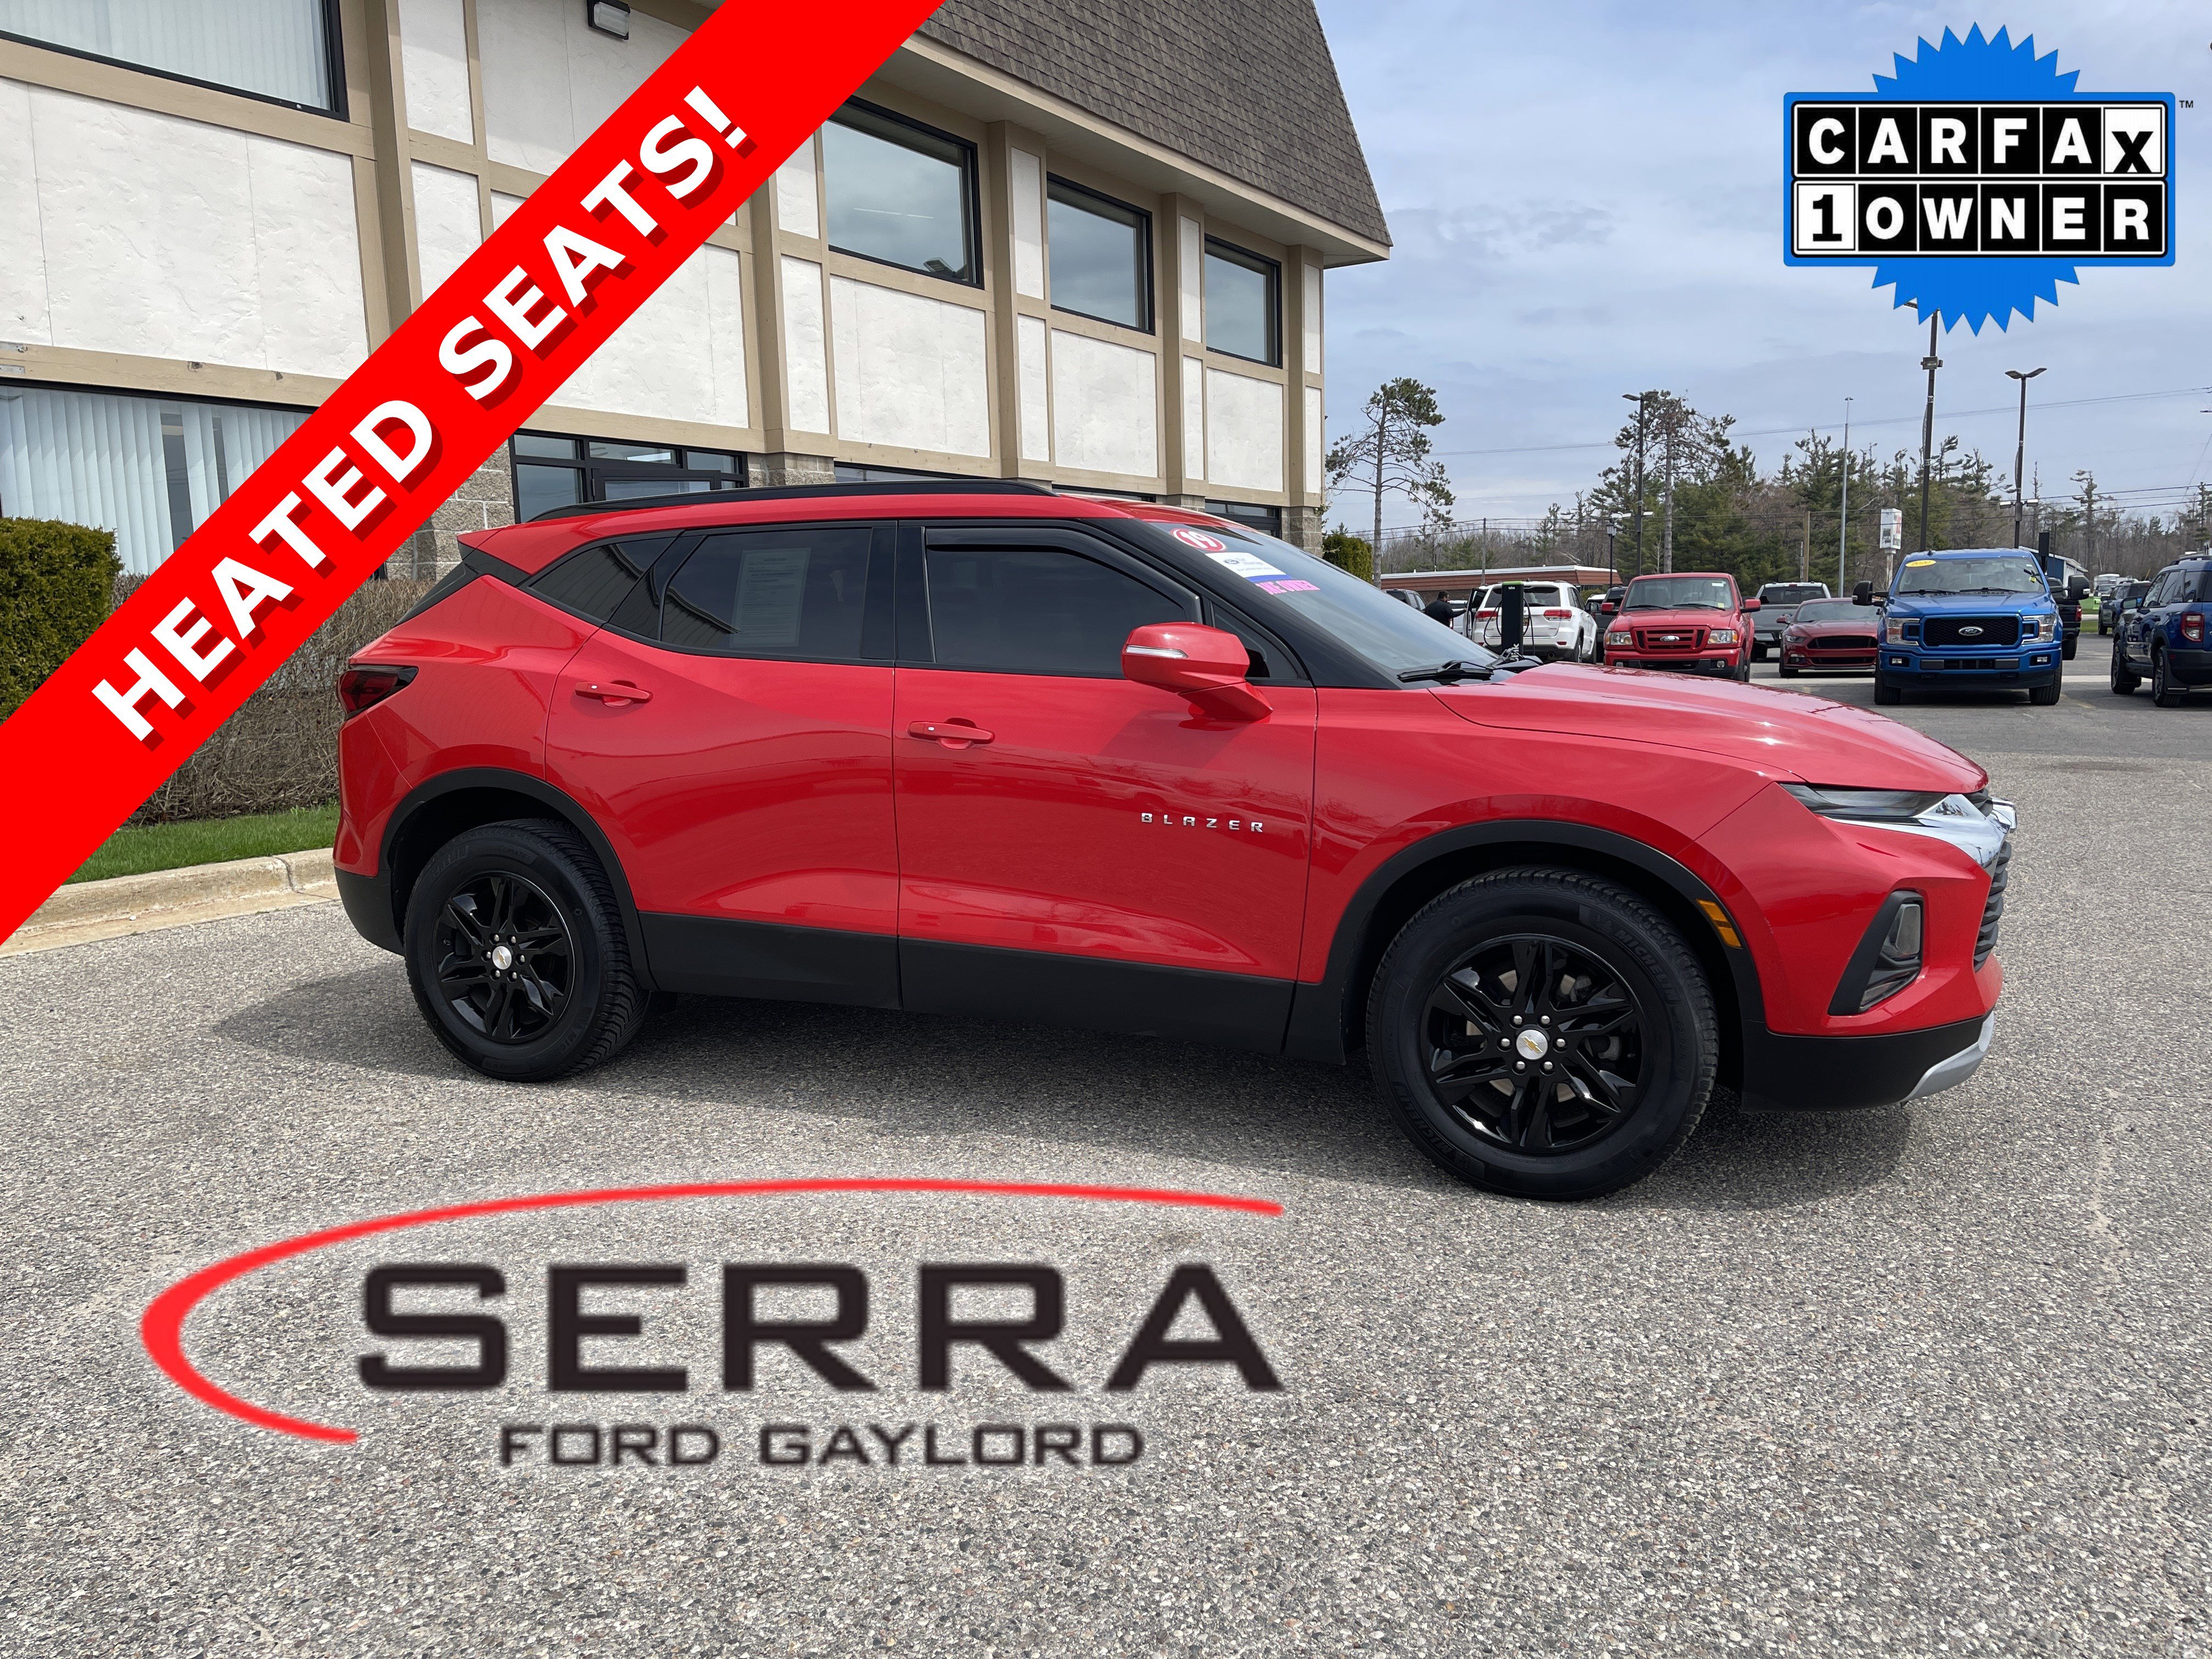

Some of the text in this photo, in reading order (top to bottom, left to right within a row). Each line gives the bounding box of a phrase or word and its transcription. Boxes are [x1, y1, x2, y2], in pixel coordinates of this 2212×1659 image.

[1180, 531, 1218, 549] 19
[1141, 812, 1263, 832] BLAZER
[1614, 928, 1681, 1002] MICHELIN
